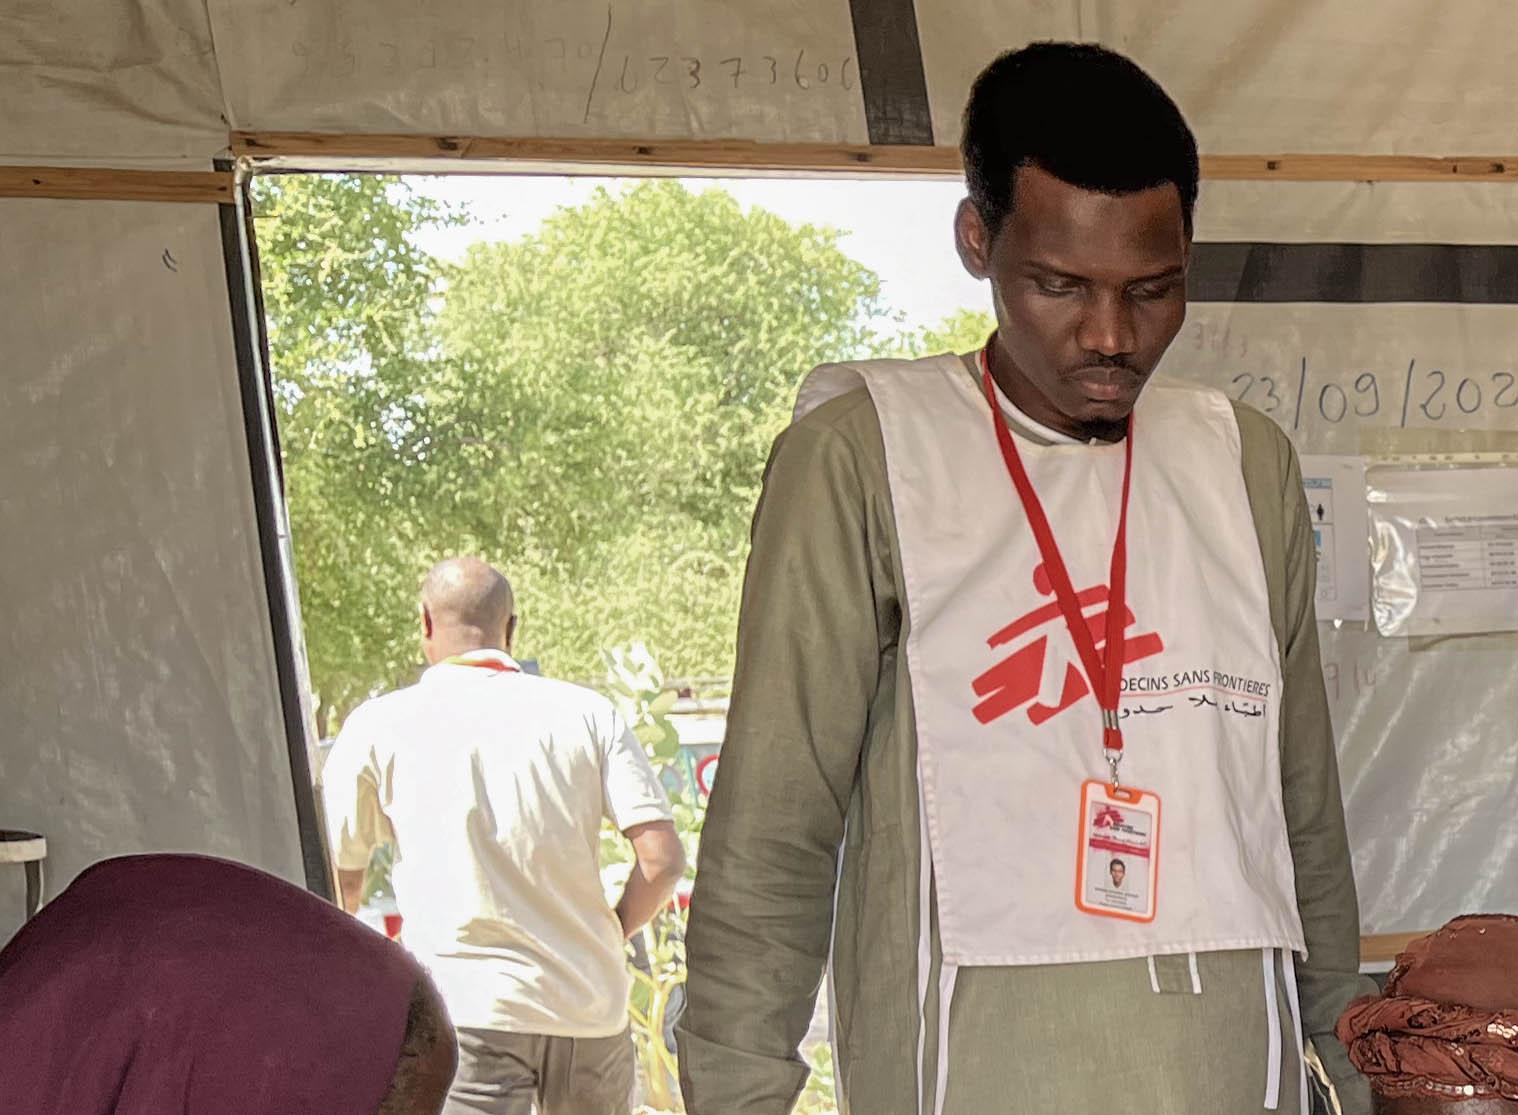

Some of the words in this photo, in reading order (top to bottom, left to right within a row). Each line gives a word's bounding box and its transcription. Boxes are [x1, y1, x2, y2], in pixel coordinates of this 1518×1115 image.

[1119, 676, 1169, 691] DECINS
[1173, 670, 1210, 688] SANS
[1212, 671, 1271, 697] FRONTIERES
